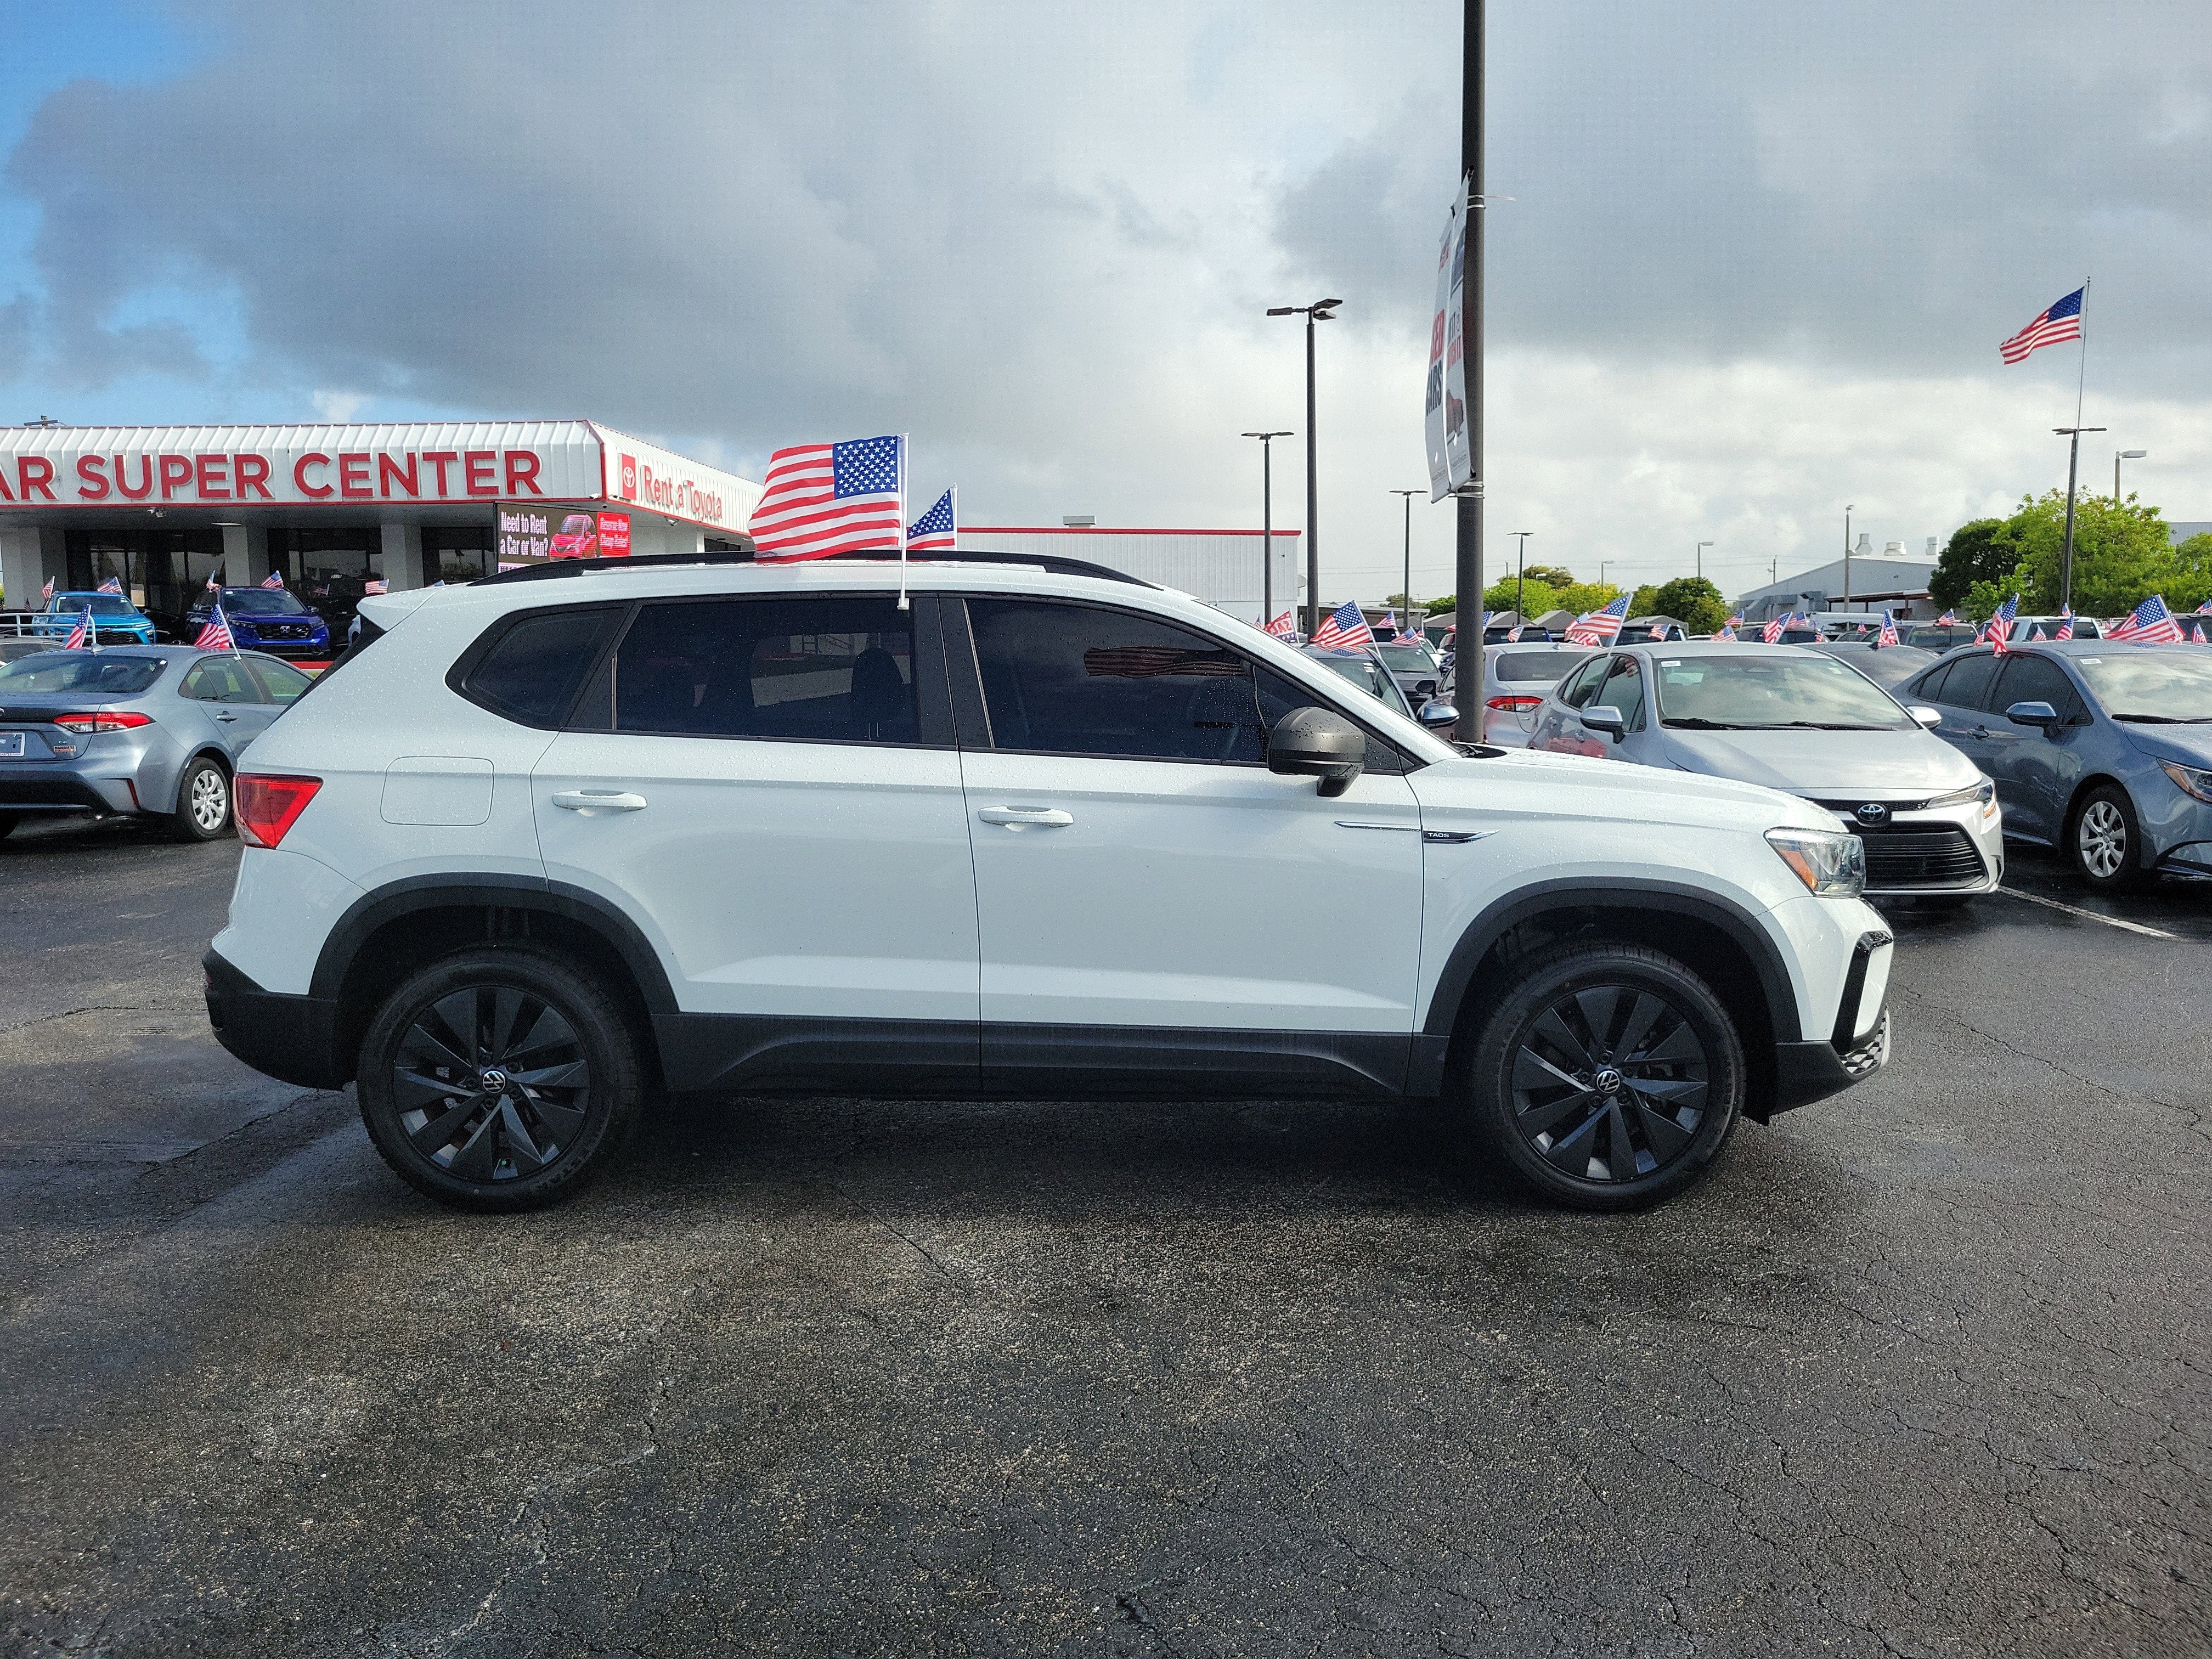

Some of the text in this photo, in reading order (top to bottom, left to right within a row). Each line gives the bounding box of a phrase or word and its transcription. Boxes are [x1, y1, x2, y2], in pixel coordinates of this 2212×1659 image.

[76, 454, 273, 499] SUPER
[294, 450, 544, 499] CENTER
[643, 465, 723, 521] Rent a Toyota
[501, 511, 548, 535] Need to Rent
[500, 534, 549, 557] a Car or Van?
